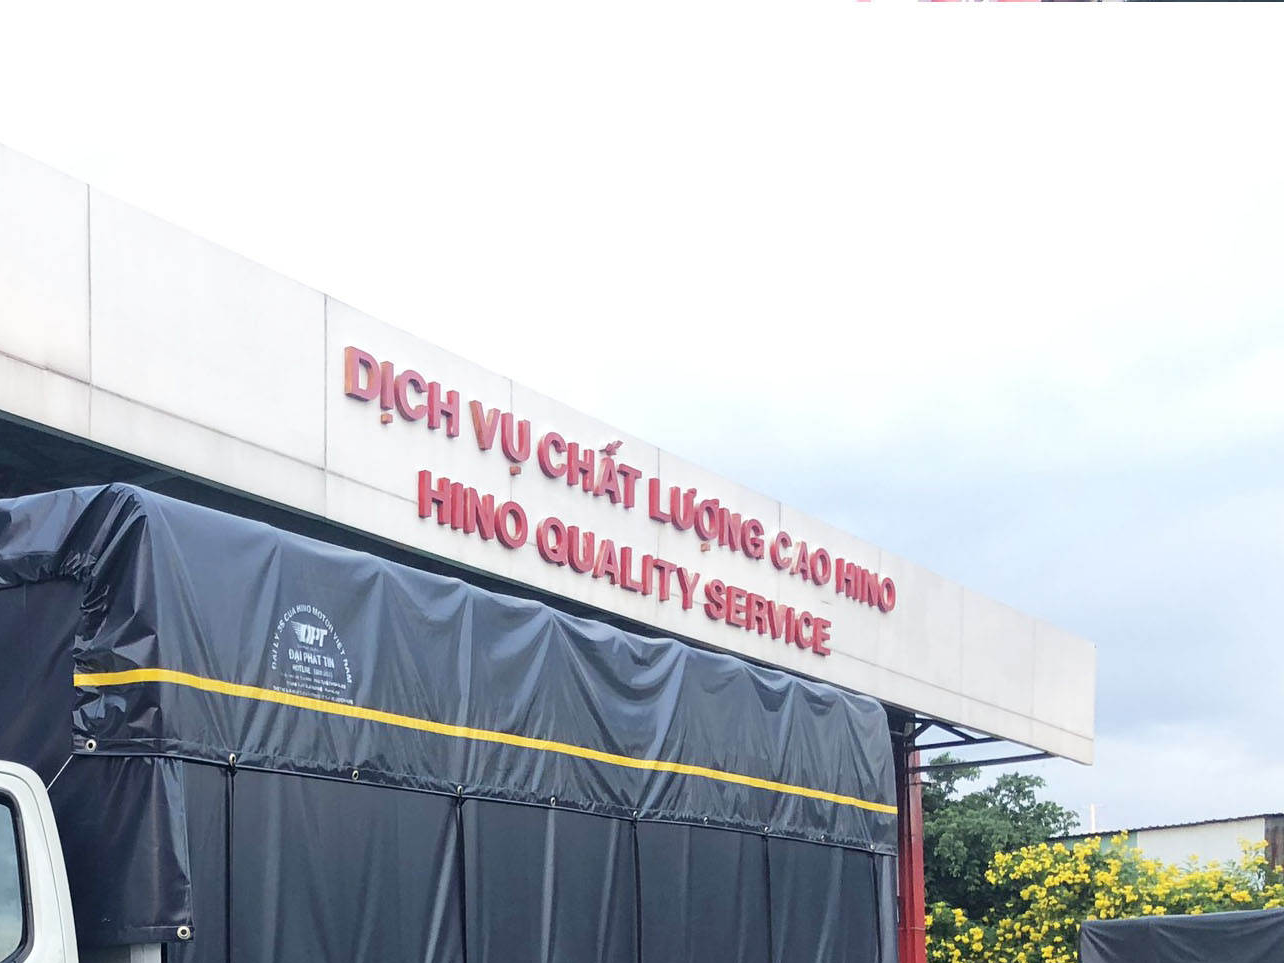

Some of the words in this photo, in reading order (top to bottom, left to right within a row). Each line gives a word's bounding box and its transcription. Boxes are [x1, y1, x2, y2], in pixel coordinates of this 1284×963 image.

[344, 345, 460, 438] DỊCH
[469, 400, 531, 475] VỤ
[538, 432, 642, 508] CHẤT
[649, 478, 765, 560] LƯỢNG
[770, 531, 831, 586] CAO
[836, 558, 896, 613] HINO
[418, 469, 528, 549] HINO
[536, 517, 700, 611] QUALITY
[704, 579, 832, 656] SERVICE
